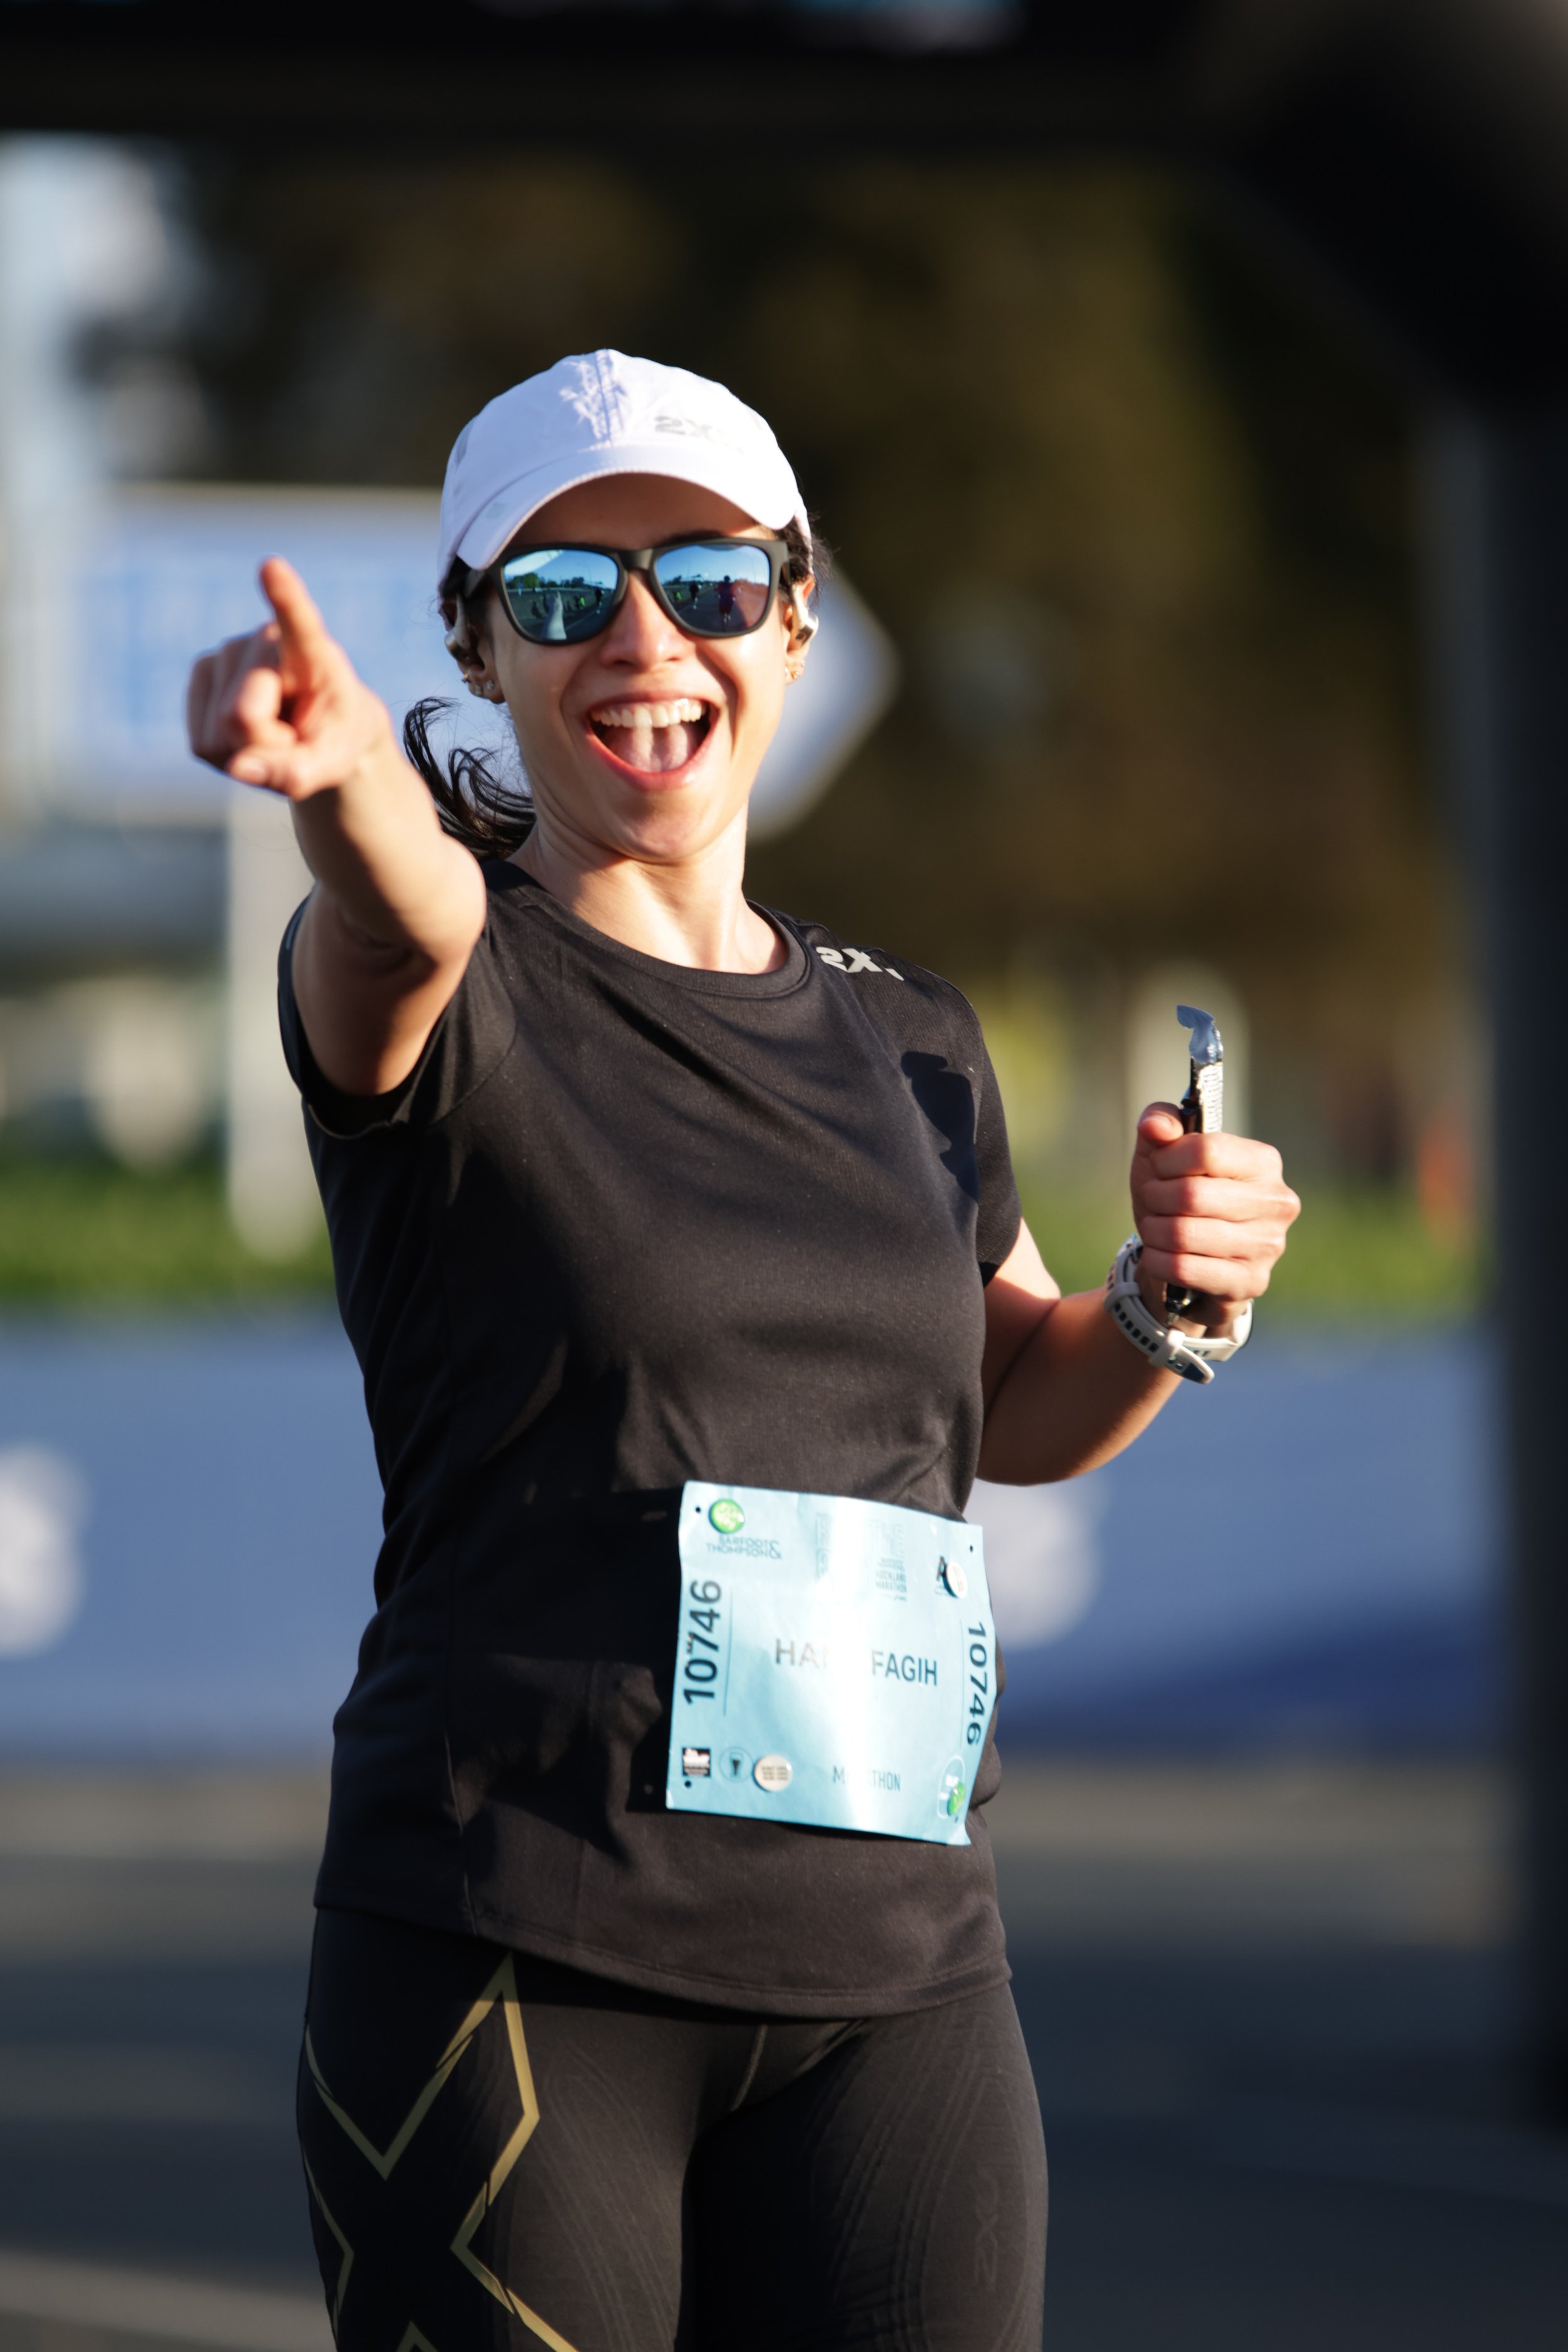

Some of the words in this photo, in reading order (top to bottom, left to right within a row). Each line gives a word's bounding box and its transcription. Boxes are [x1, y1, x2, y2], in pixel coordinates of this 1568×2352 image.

[683, 1580, 722, 1705] 10746
[871, 1649, 938, 1687] FAGIH
[967, 1621, 988, 1746] 10746
